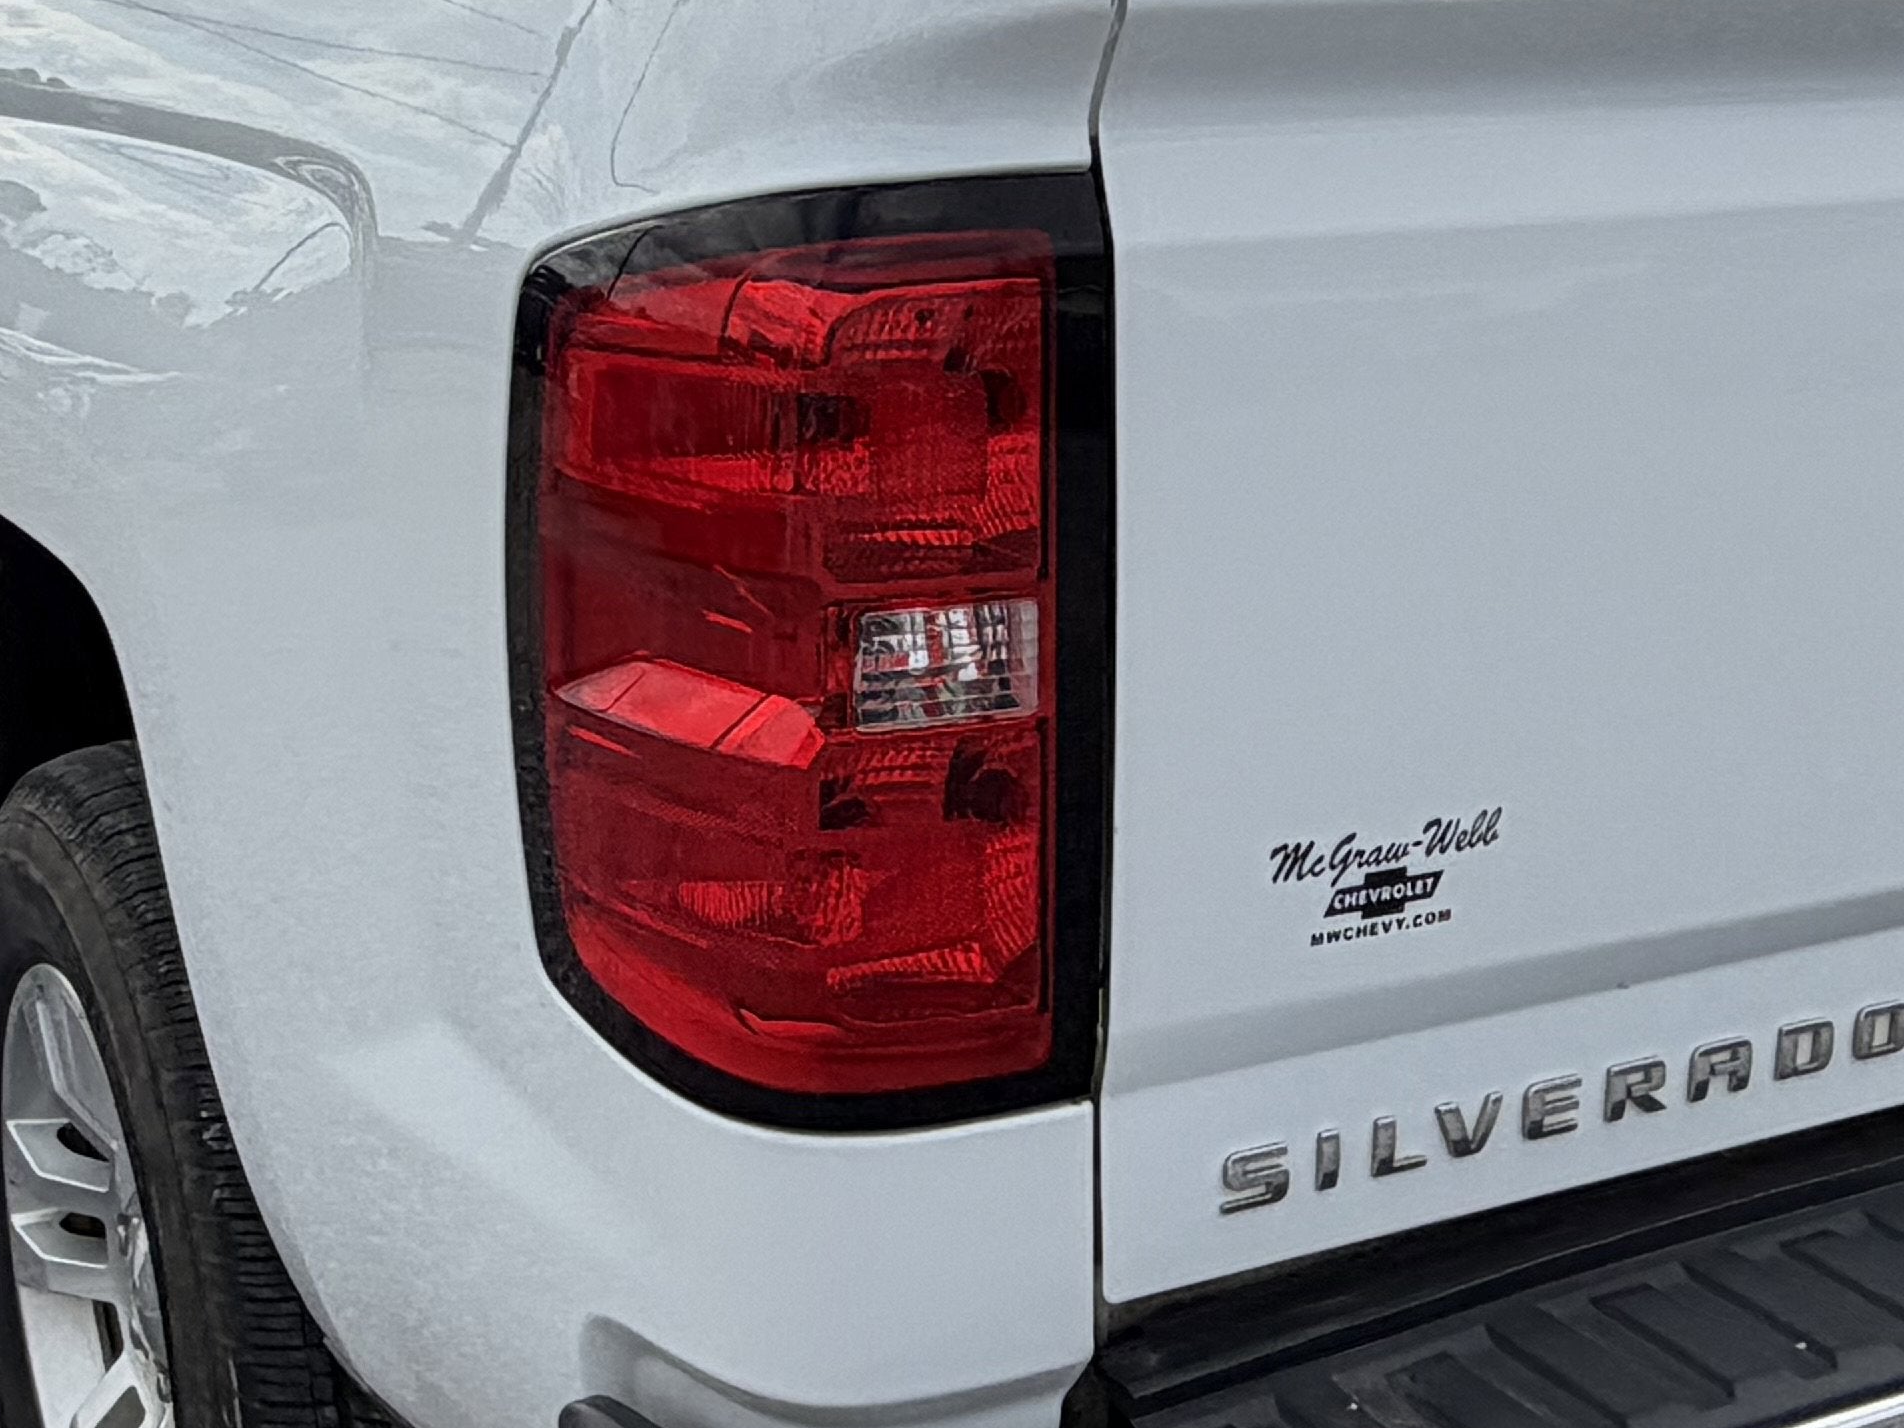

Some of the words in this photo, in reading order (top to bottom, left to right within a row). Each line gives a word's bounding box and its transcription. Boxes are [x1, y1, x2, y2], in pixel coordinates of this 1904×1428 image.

[1269, 806, 1503, 887] McGraw-Webb
[1331, 876, 1436, 910] CHEVROLET
[1309, 908, 1452, 947] MWCHEVY.COM
